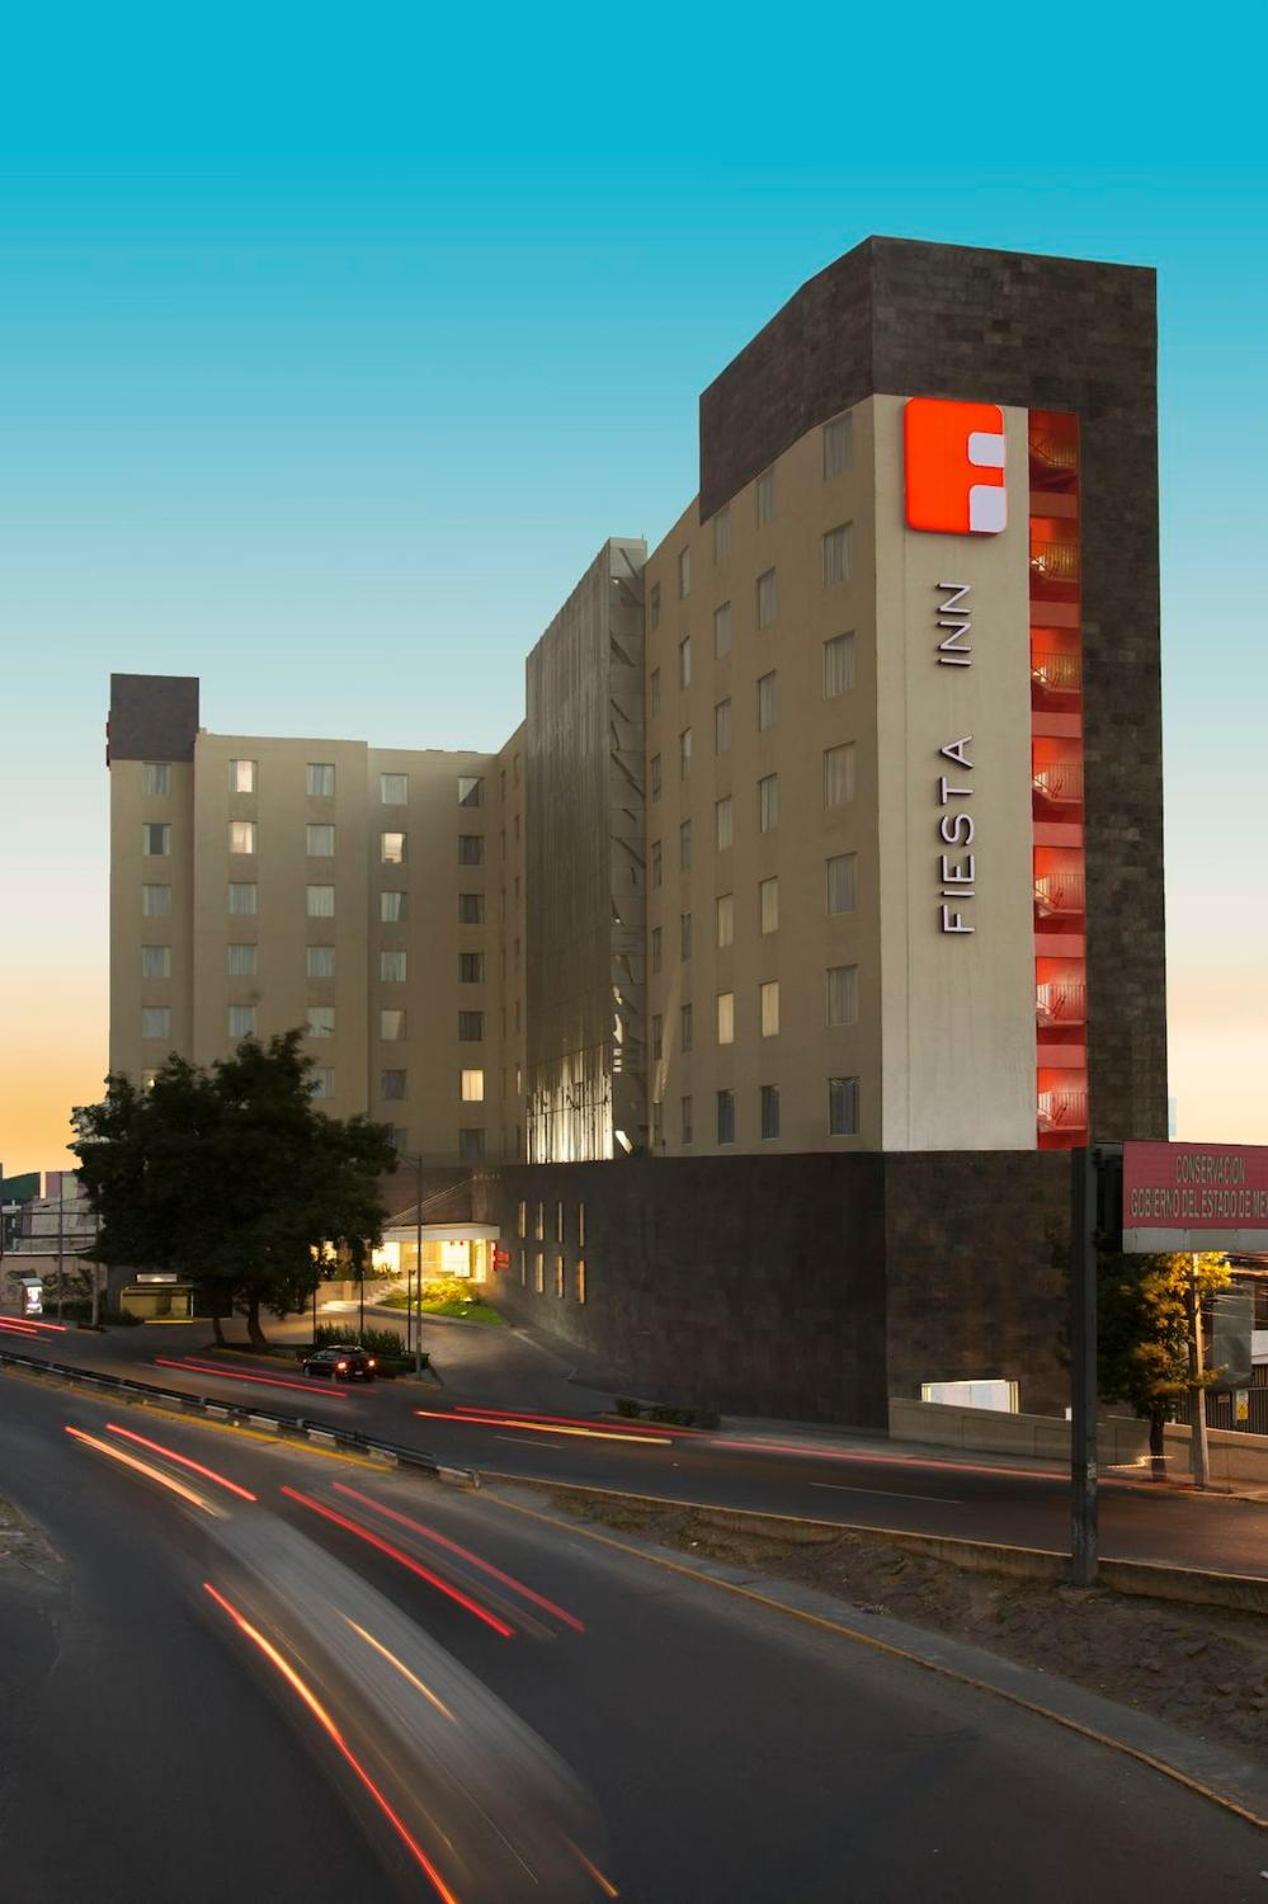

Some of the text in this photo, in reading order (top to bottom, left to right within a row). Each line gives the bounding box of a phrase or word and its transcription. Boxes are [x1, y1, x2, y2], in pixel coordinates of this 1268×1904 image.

[938, 582, 975, 933] FIESTA INN
[1132, 1187, 1180, 1218] GOBIERNO
[1182, 1188, 1201, 1218] DEL
[1202, 1188, 1238, 1218] ESTADO
[1239, 1188, 1251, 1218] DE
